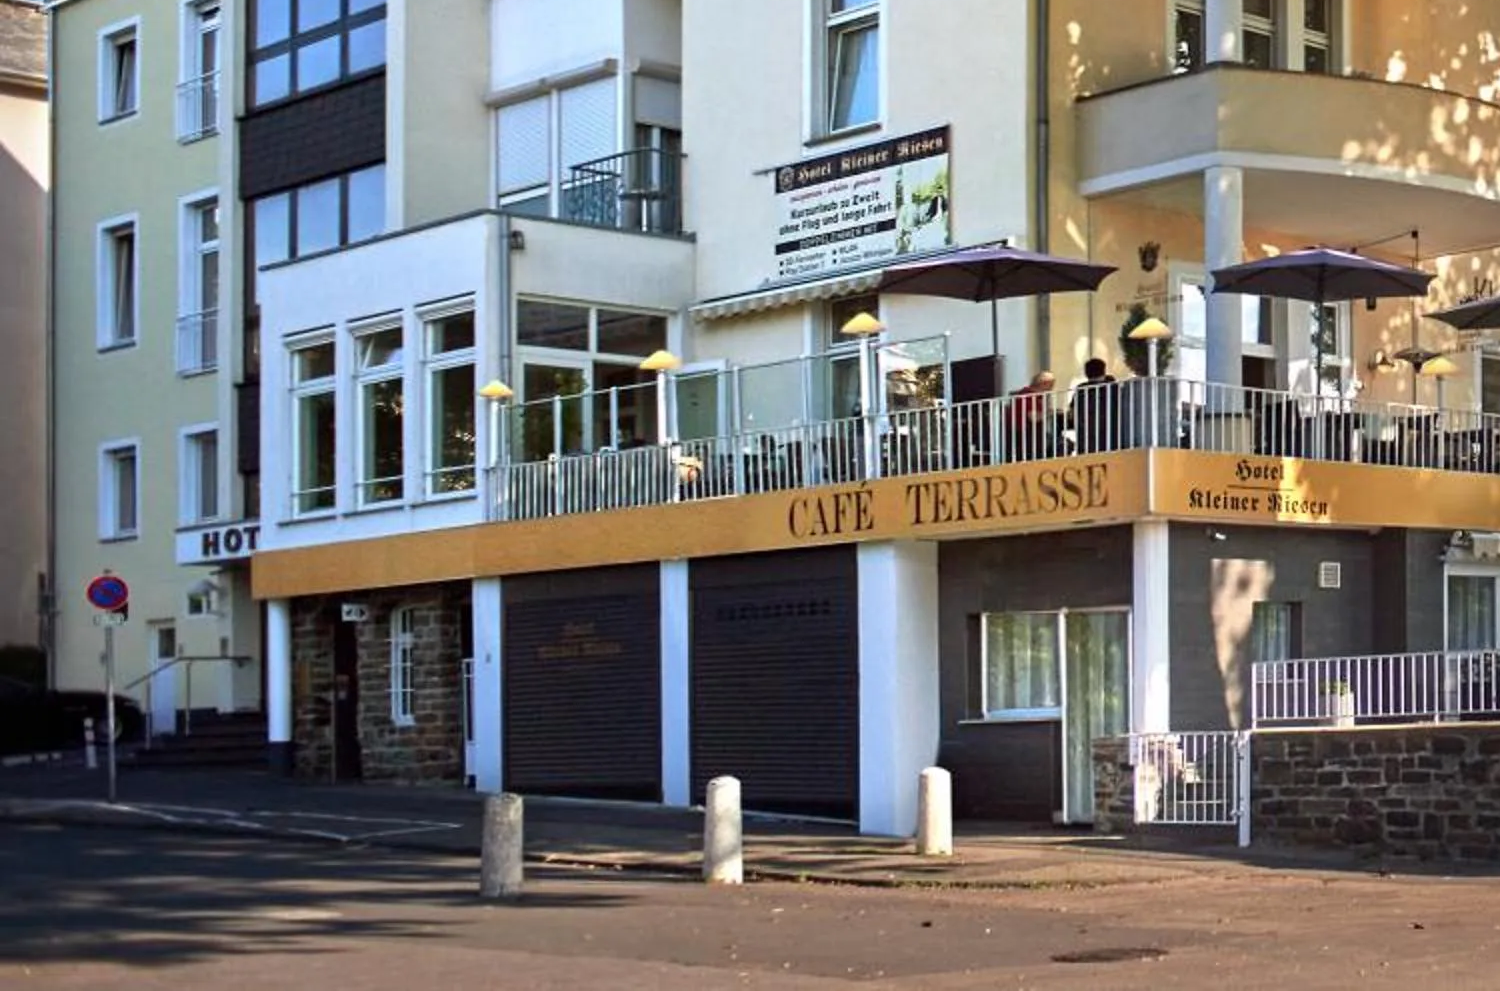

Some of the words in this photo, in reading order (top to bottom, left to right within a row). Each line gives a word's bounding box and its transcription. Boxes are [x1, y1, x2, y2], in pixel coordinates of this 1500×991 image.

[798, 162, 832, 181] Hotel
[1235, 459, 1285, 482] Hotel
[788, 480, 875, 539] CAFÉ
[906, 463, 1110, 526] TERRASSE
[1189, 487, 1260, 512] Kleiner
[1267, 492, 1328, 516] Riesen
